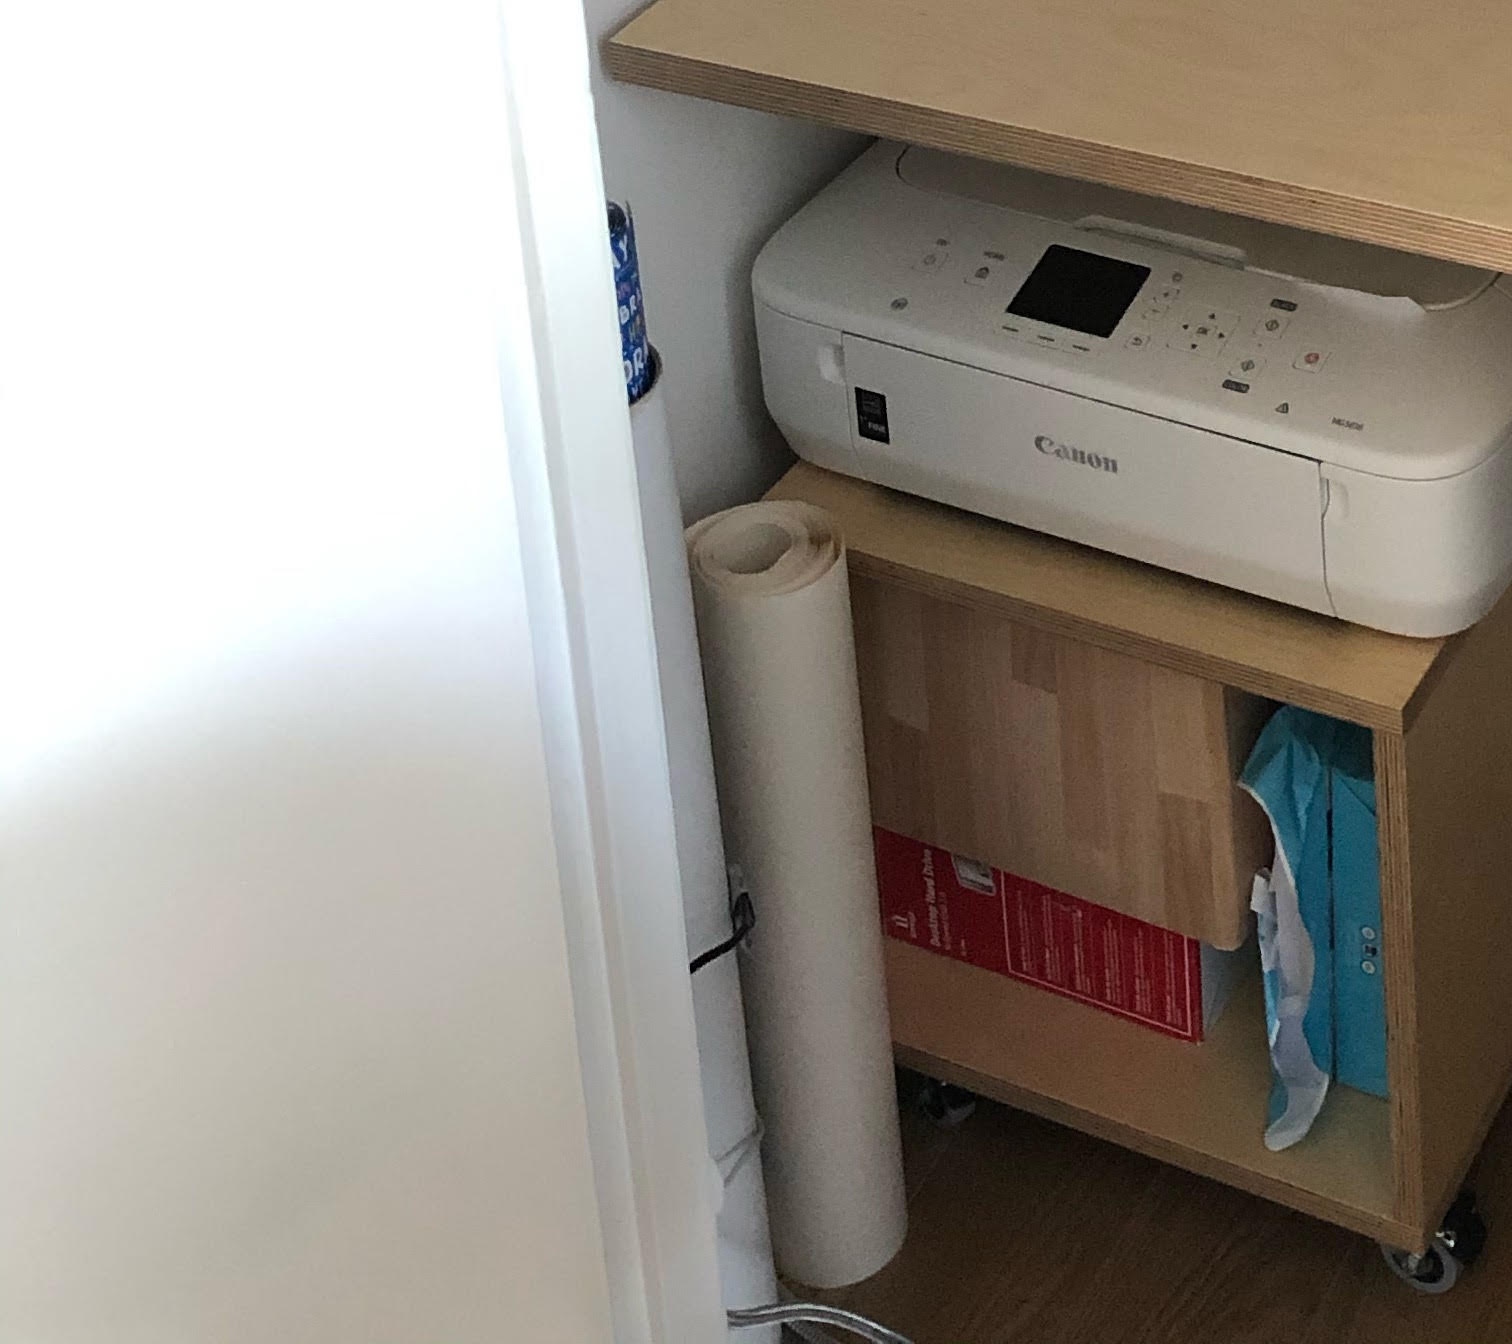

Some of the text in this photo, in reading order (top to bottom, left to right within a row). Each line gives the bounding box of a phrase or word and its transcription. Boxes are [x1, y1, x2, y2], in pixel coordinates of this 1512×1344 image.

[1033, 434, 1120, 475] Canon
[922, 848, 935, 876] Drive
[924, 876, 938, 904] Hard
